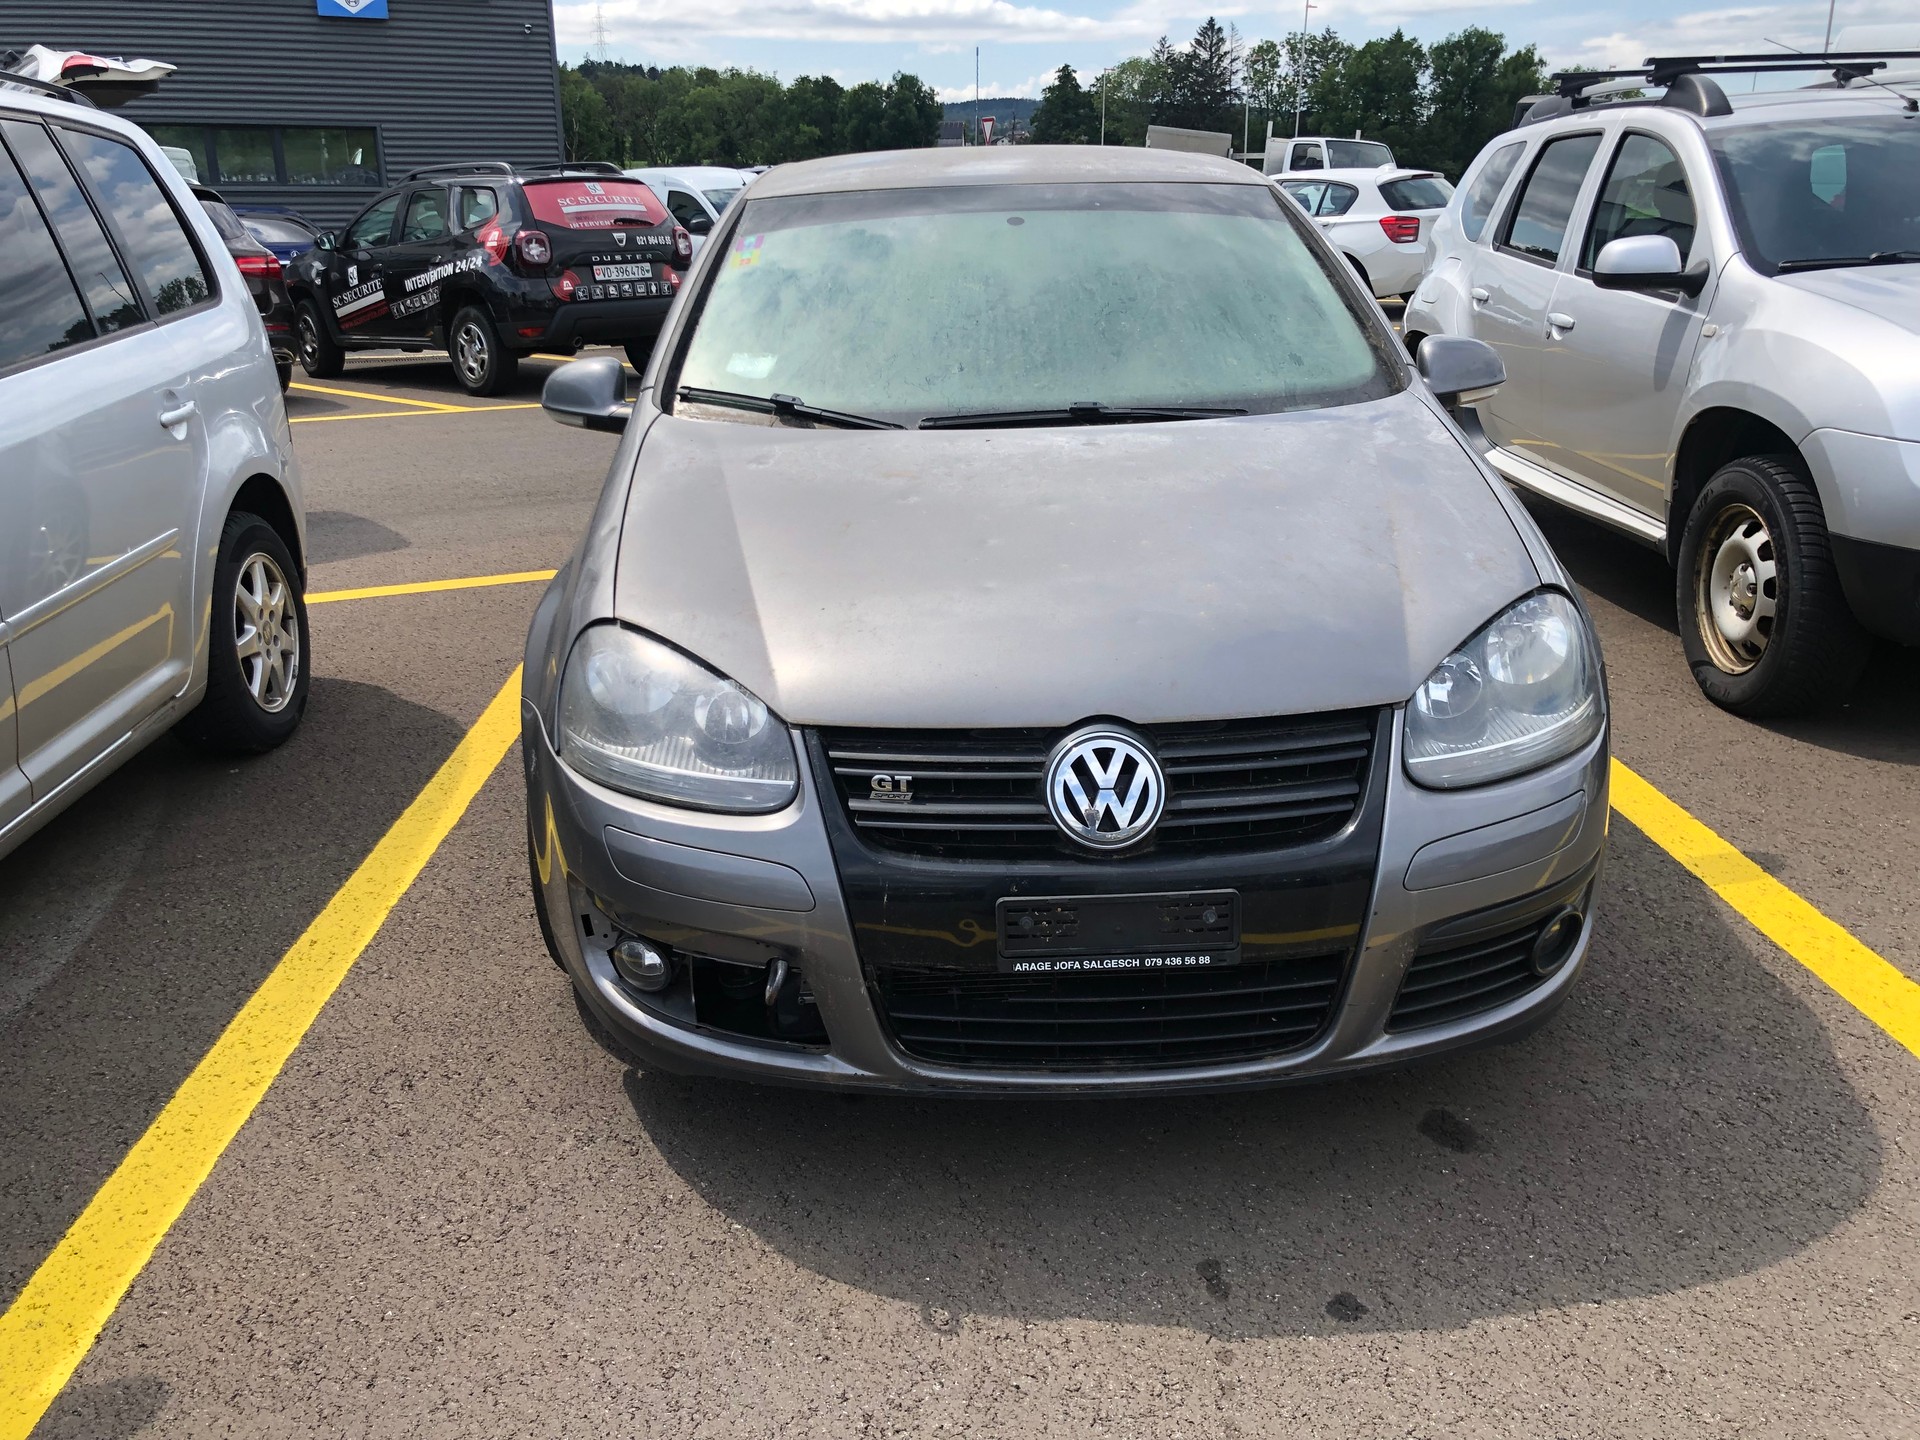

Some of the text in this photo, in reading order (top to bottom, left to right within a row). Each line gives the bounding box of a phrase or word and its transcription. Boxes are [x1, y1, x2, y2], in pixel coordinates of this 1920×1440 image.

[557, 197, 577, 206] SC
[636, 235, 648, 245] 021
[592, 253, 653, 262] DUSTER
[404, 255, 483, 292] INTERVENTION 24/24
[332, 295, 343, 308] SC
[871, 774, 912, 792] GT
[1013, 955, 1211, 972] ARAGE JOFA SALGESCH 079 436 56 88
